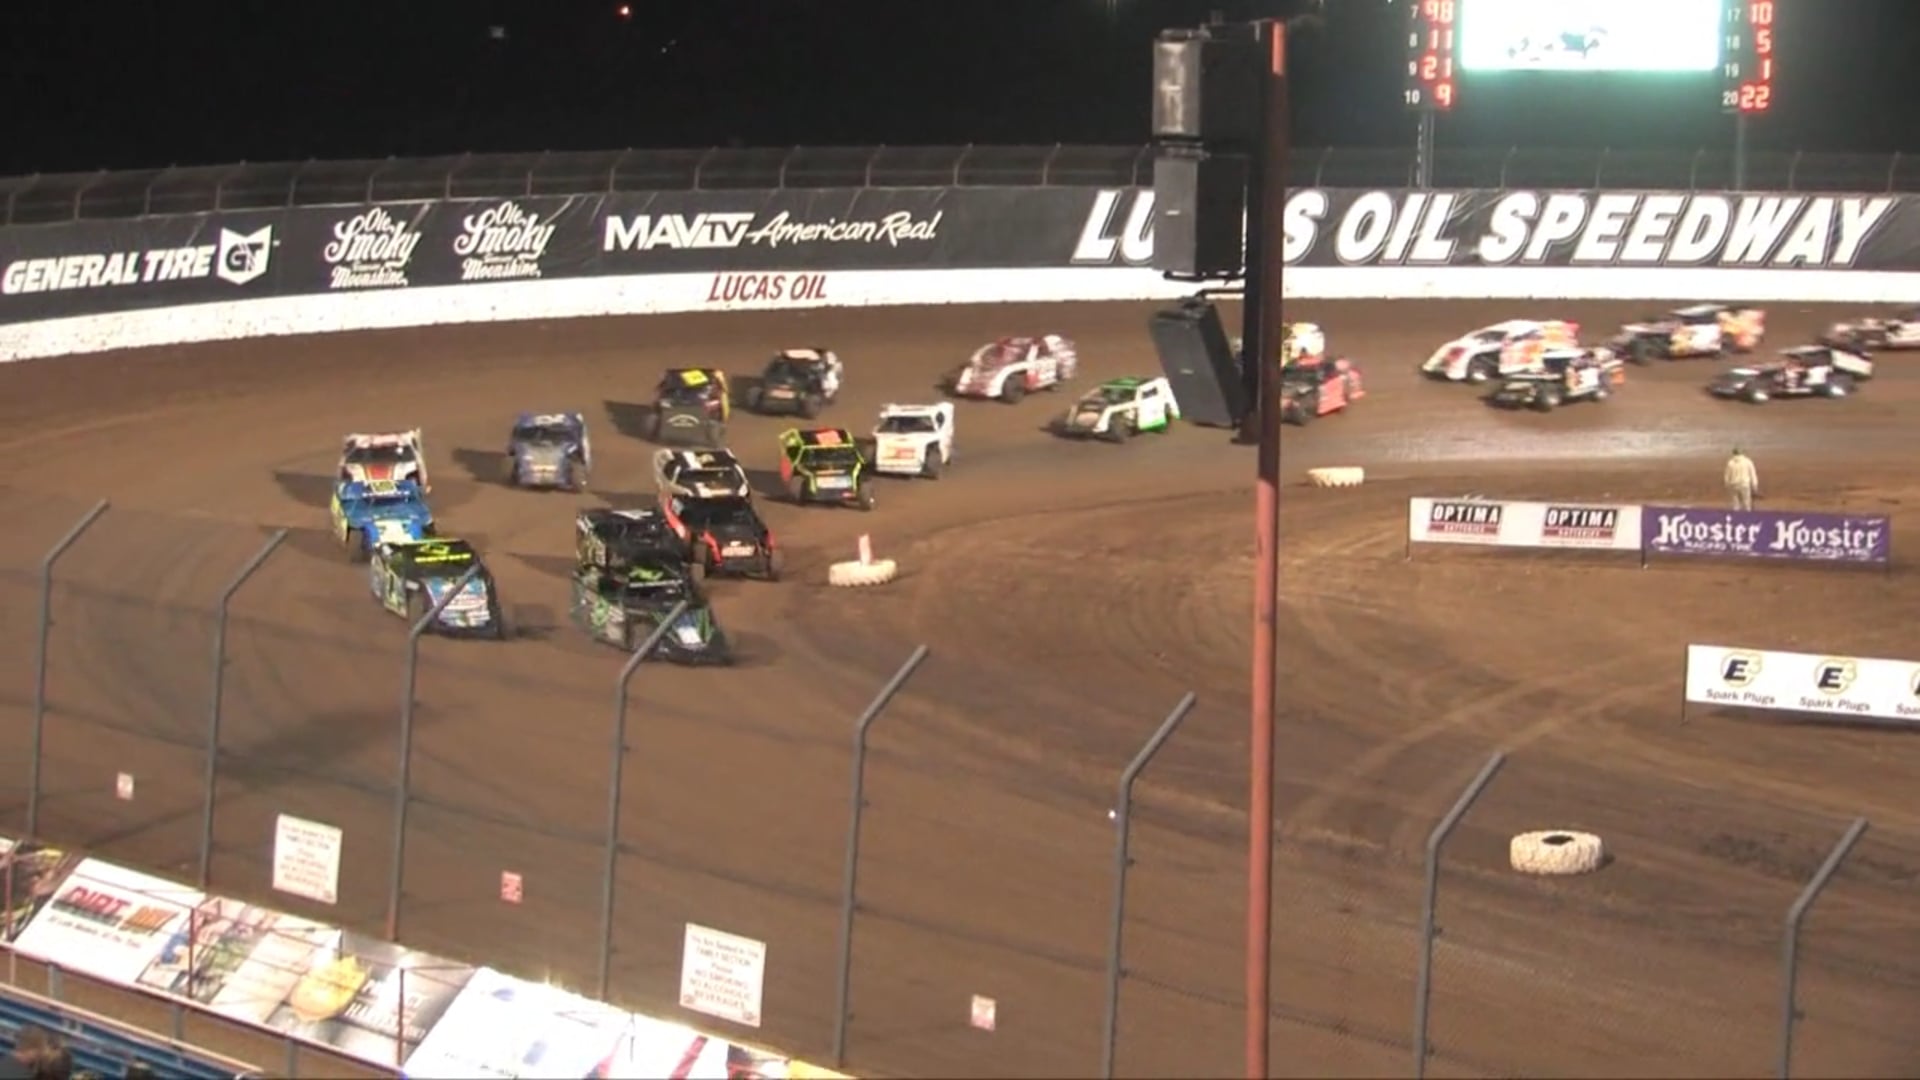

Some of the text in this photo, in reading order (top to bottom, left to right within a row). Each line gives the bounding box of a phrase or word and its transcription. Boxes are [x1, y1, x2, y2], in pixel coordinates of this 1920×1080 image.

[1410, 0, 1453, 23] 7 98
[1727, 1, 1773, 24] 17 10
[1431, 29, 1453, 49] 11
[1726, 29, 1771, 53] 18 5
[1408, 55, 1452, 80] 9 21
[1725, 59, 1771, 80] 19 1
[1404, 84, 1451, 107] 10 9
[1722, 84, 1770, 109] 20 22
[363, 207, 395, 232] Ole
[496, 201, 527, 225] Ole
[454, 208, 555, 260] Smoky
[604, 213, 755, 251] MAVTV
[746, 211, 875, 248] American
[1070, 190, 1895, 266] LUS OIL SPEEDWAY
[324, 215, 422, 268] Smoky
[2, 252, 140, 295] GENERAL
[143, 245, 217, 283] TIRE
[706, 274, 828, 302] LUCAS OIL
[1433, 504, 1500, 525] OPTIMA
[1547, 508, 1615, 528] OPTIMA
[1651, 512, 1763, 546] Hoosier
[1769, 518, 1882, 551] Hoosier
[1706, 687, 1776, 705] Spark Plugs
[1799, 696, 1871, 712] Spark Plugs
